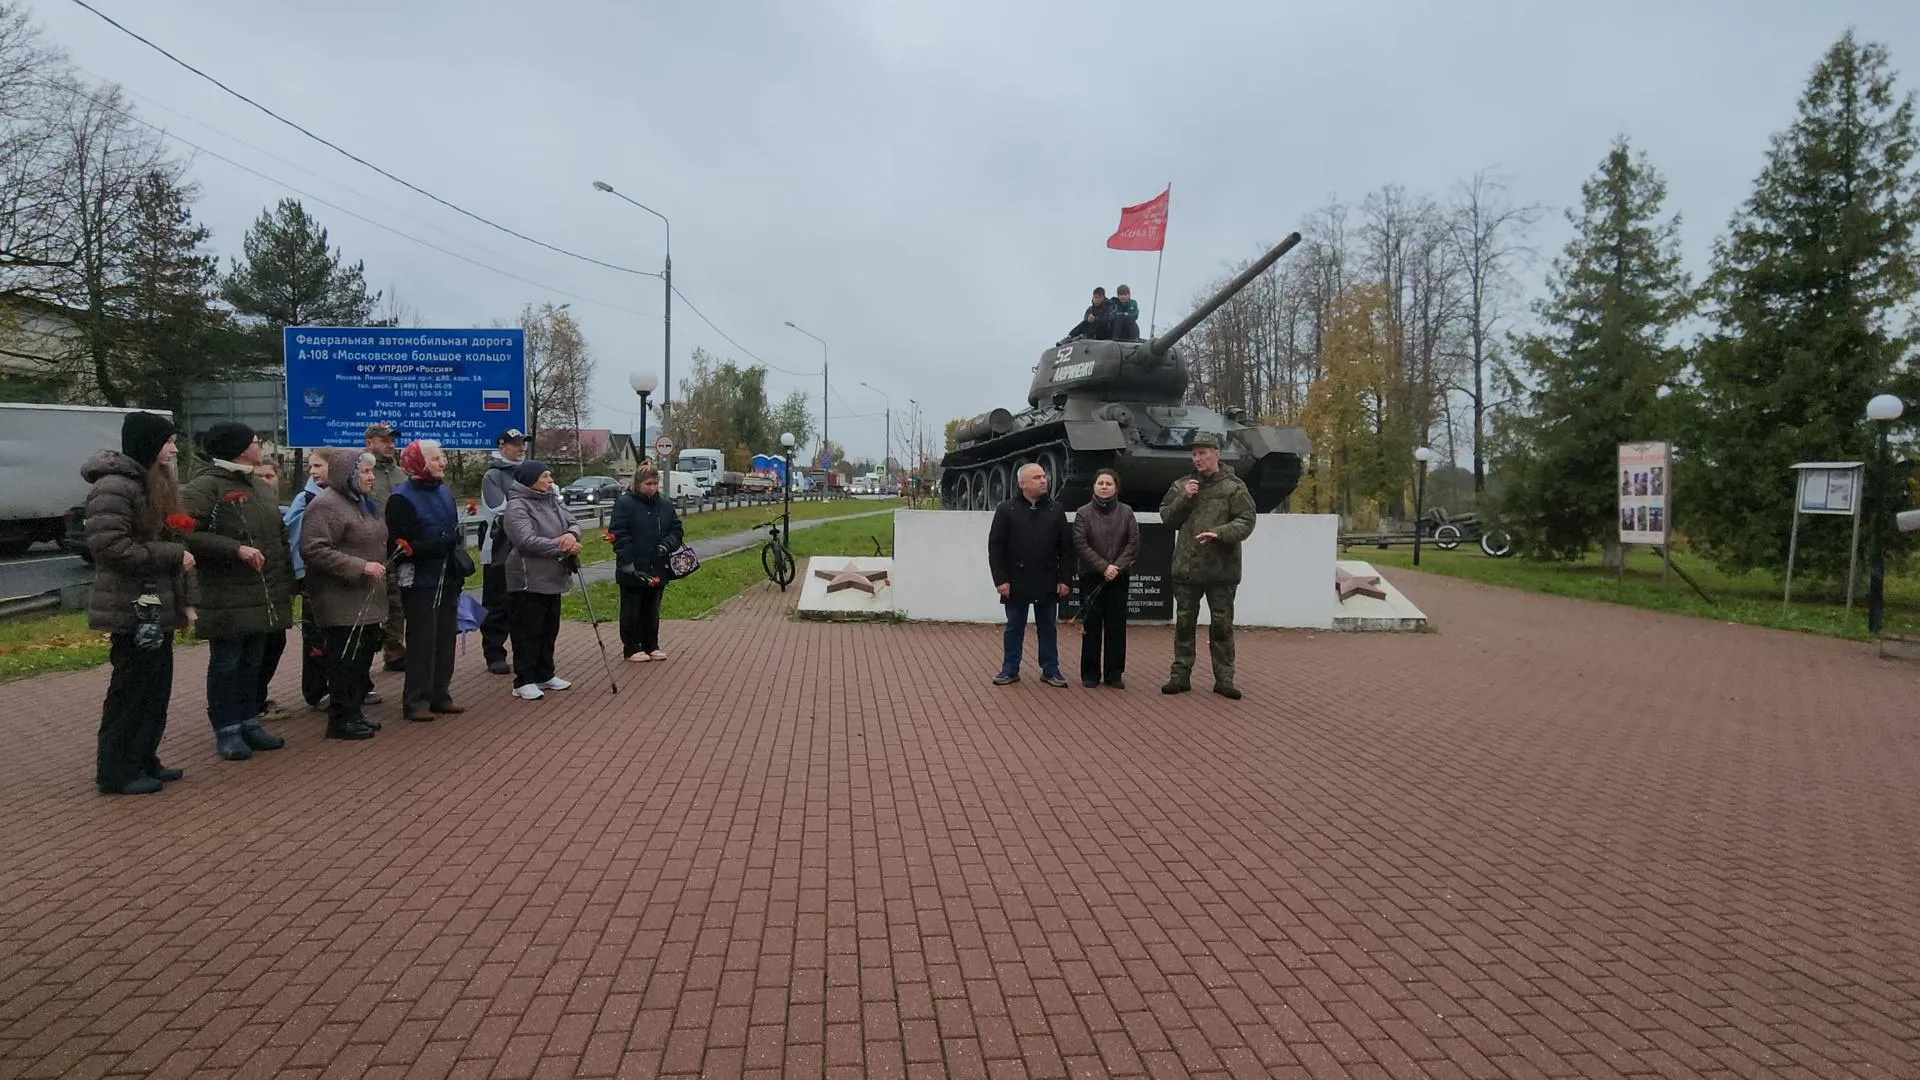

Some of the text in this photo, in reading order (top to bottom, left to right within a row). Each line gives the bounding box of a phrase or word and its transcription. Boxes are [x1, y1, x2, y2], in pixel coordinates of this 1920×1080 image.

[296, 334, 513, 348] Федеральная автомобильная дорога
[298, 350, 512, 363] А-108 «Московское большое кольцо»
[1054, 346, 1074, 364] 52
[357, 365, 454, 374] ФКУ УПРДОР «Россия»
[375, 400, 437, 410] Участок дороги
[369, 410, 402, 418] 387+906
[423, 410, 457, 418] 503+894
